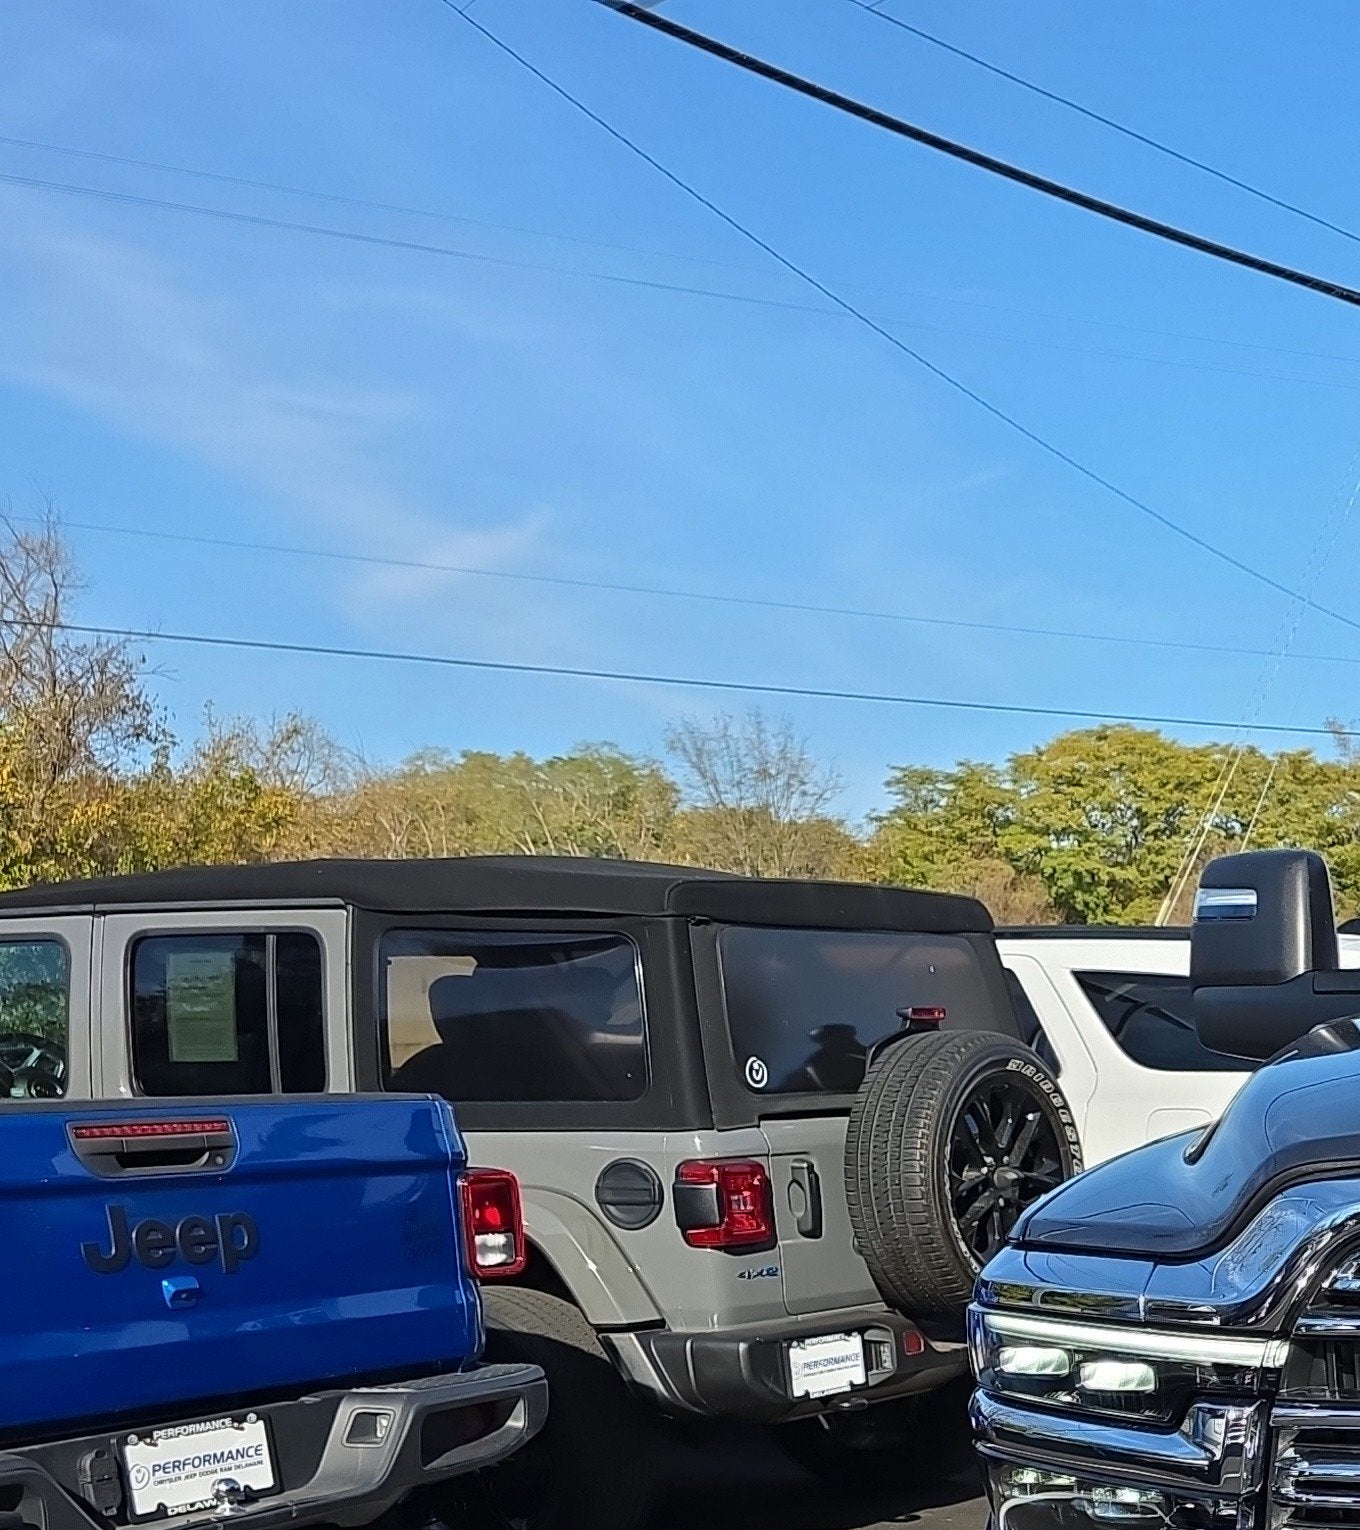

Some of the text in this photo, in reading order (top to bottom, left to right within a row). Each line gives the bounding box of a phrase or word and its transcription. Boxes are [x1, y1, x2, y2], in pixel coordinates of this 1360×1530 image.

[1006, 1059, 1082, 1177] BRIDGESTO
[80, 1203, 259, 1275] Jeep
[803, 1352, 861, 1369] PERFORMANCE
[152, 1417, 234, 1441] PERFORMANCE
[152, 1444, 263, 1477] PERFORMANCE
[153, 1460, 264, 1487] CHRYSLER JEEP DODGE RAM DELAWARE
[167, 1497, 218, 1517] DELAW
